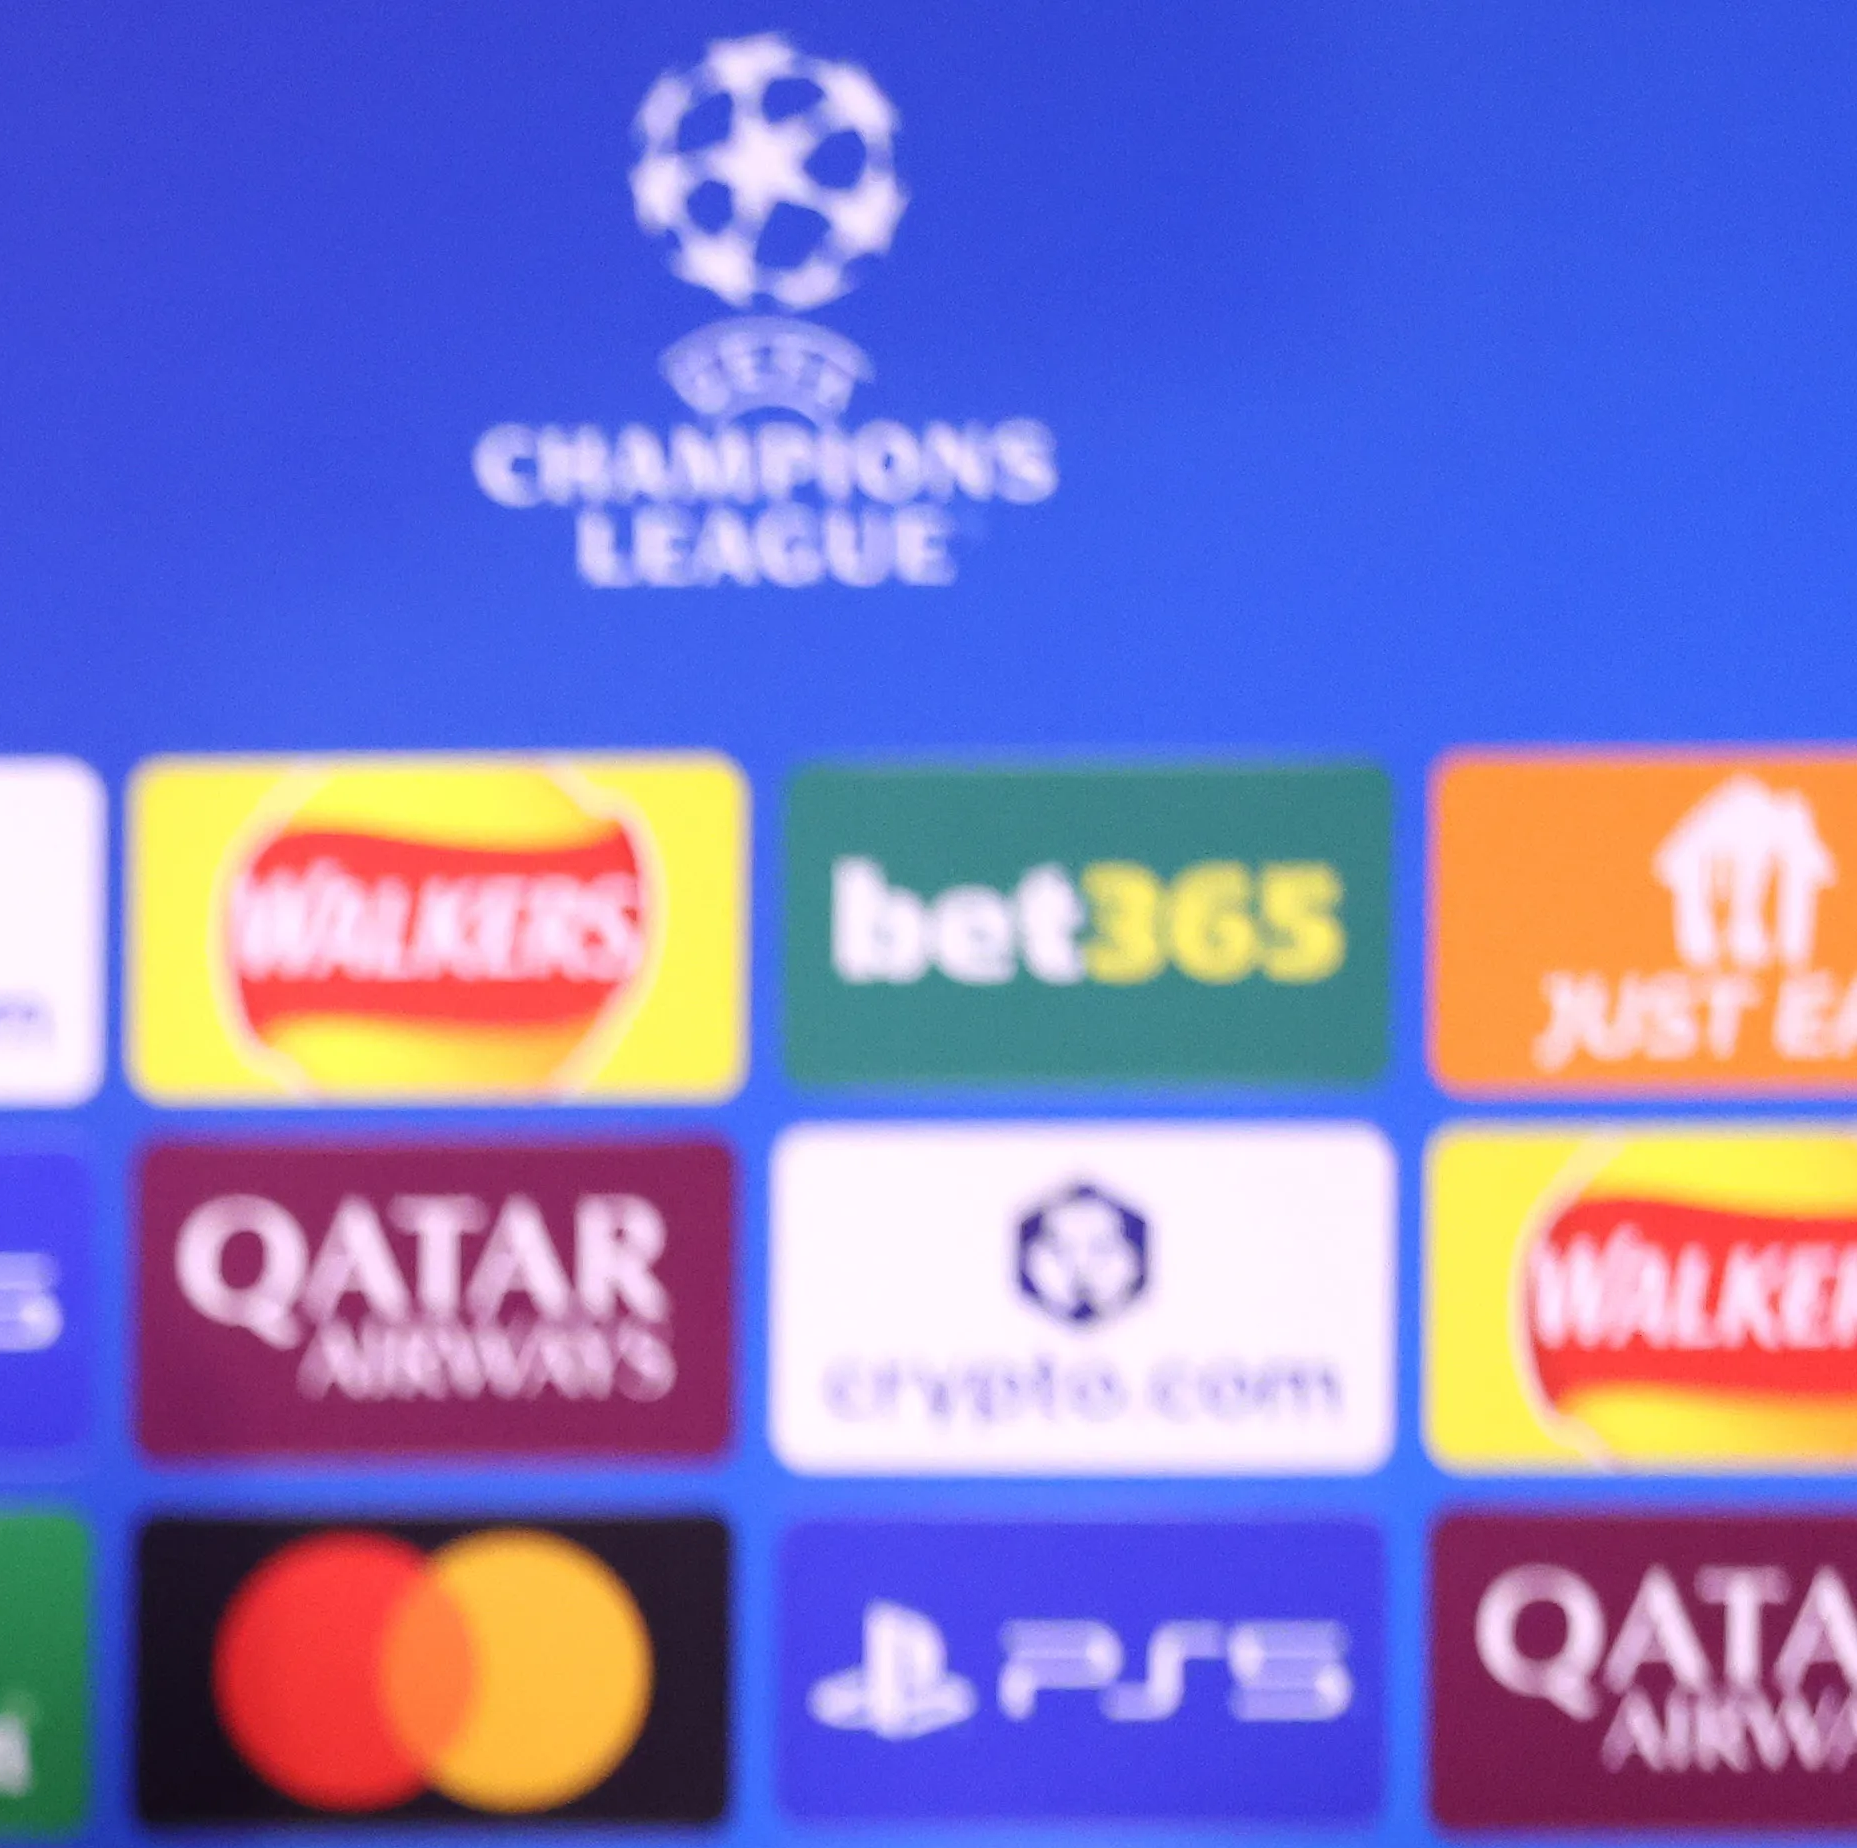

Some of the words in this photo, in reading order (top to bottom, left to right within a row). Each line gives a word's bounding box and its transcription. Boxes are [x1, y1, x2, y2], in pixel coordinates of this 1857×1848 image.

[472, 419, 1058, 509] CHAMPIONS
[576, 503, 958, 589] LEAGUE
[235, 863, 643, 984] WALKERS
[833, 855, 1348, 987] bet365
[1531, 968, 1761, 1075] JUST
[175, 1194, 669, 1351] QATAR
[1530, 1221, 1857, 1352] WALKE
[297, 1320, 676, 1403] AIRWAYS
[821, 1351, 1345, 1430] crypto.com
[999, 1619, 1352, 1723] PS5
[1475, 1562, 1857, 1721] QATA
